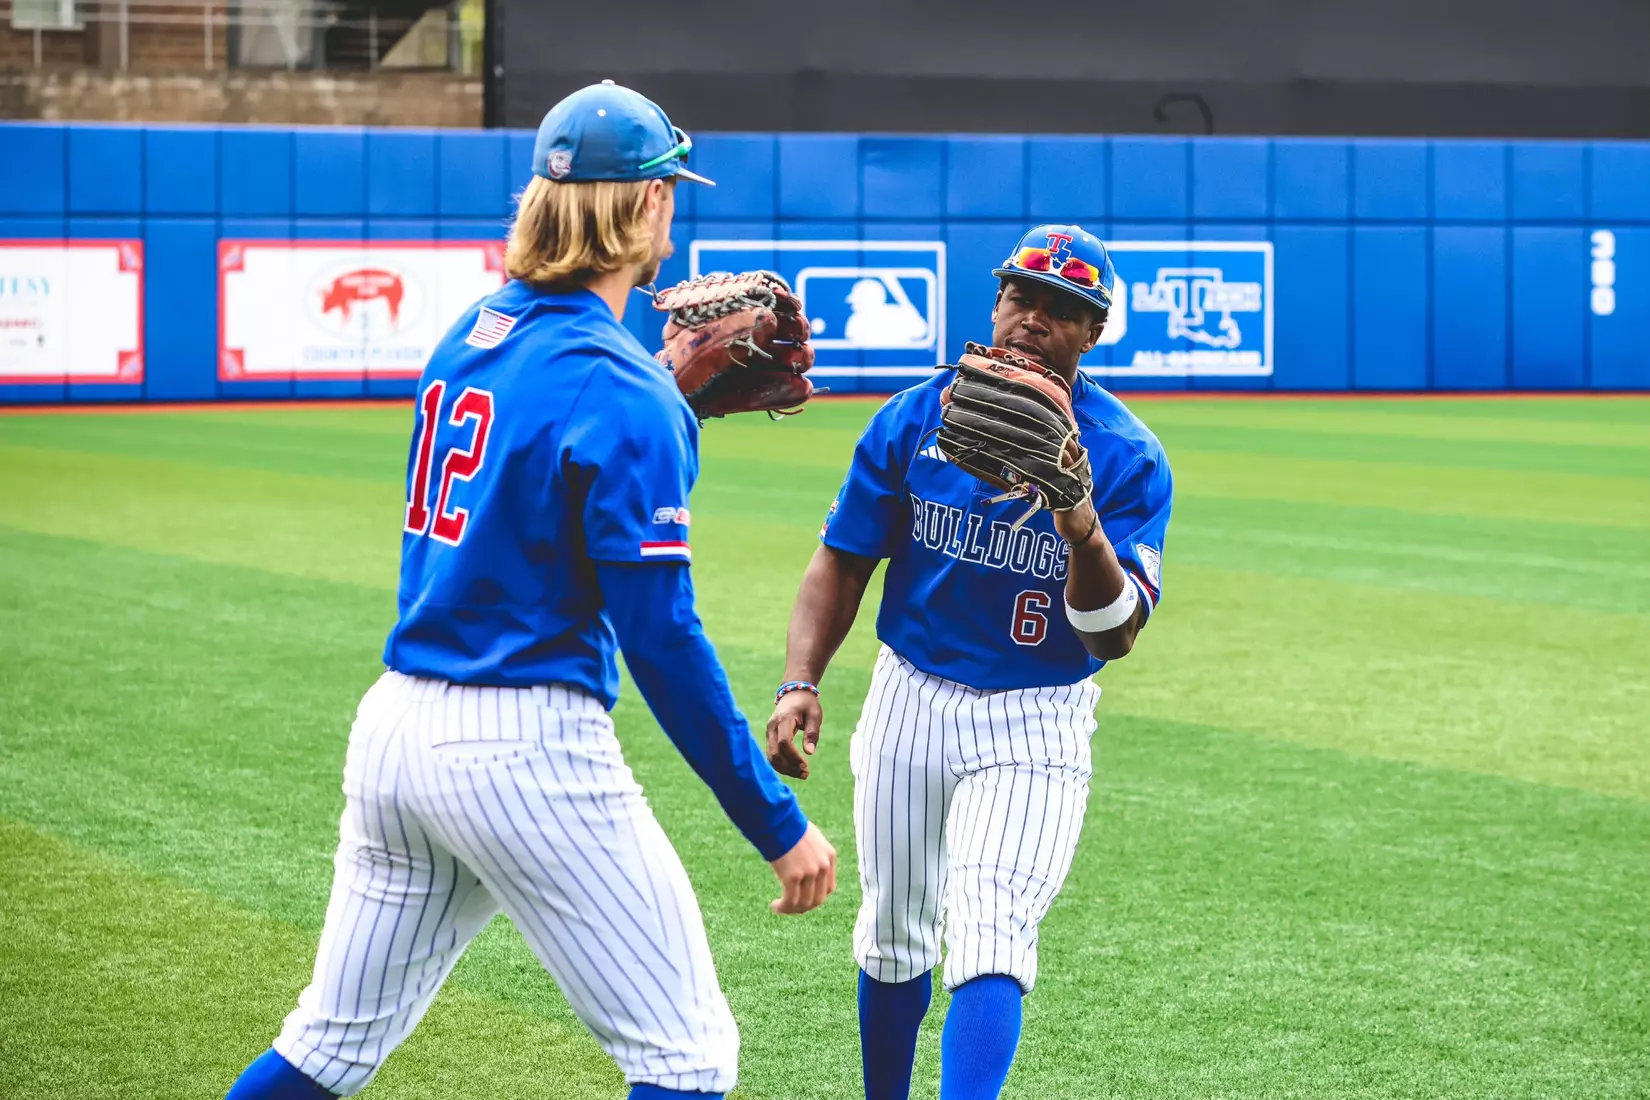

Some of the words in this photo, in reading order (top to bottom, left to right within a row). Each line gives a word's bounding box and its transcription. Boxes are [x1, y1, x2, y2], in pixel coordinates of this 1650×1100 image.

[404, 379, 495, 547] 12
[909, 493, 1069, 581] BULLDOGS
[1010, 590, 1051, 646] 6
